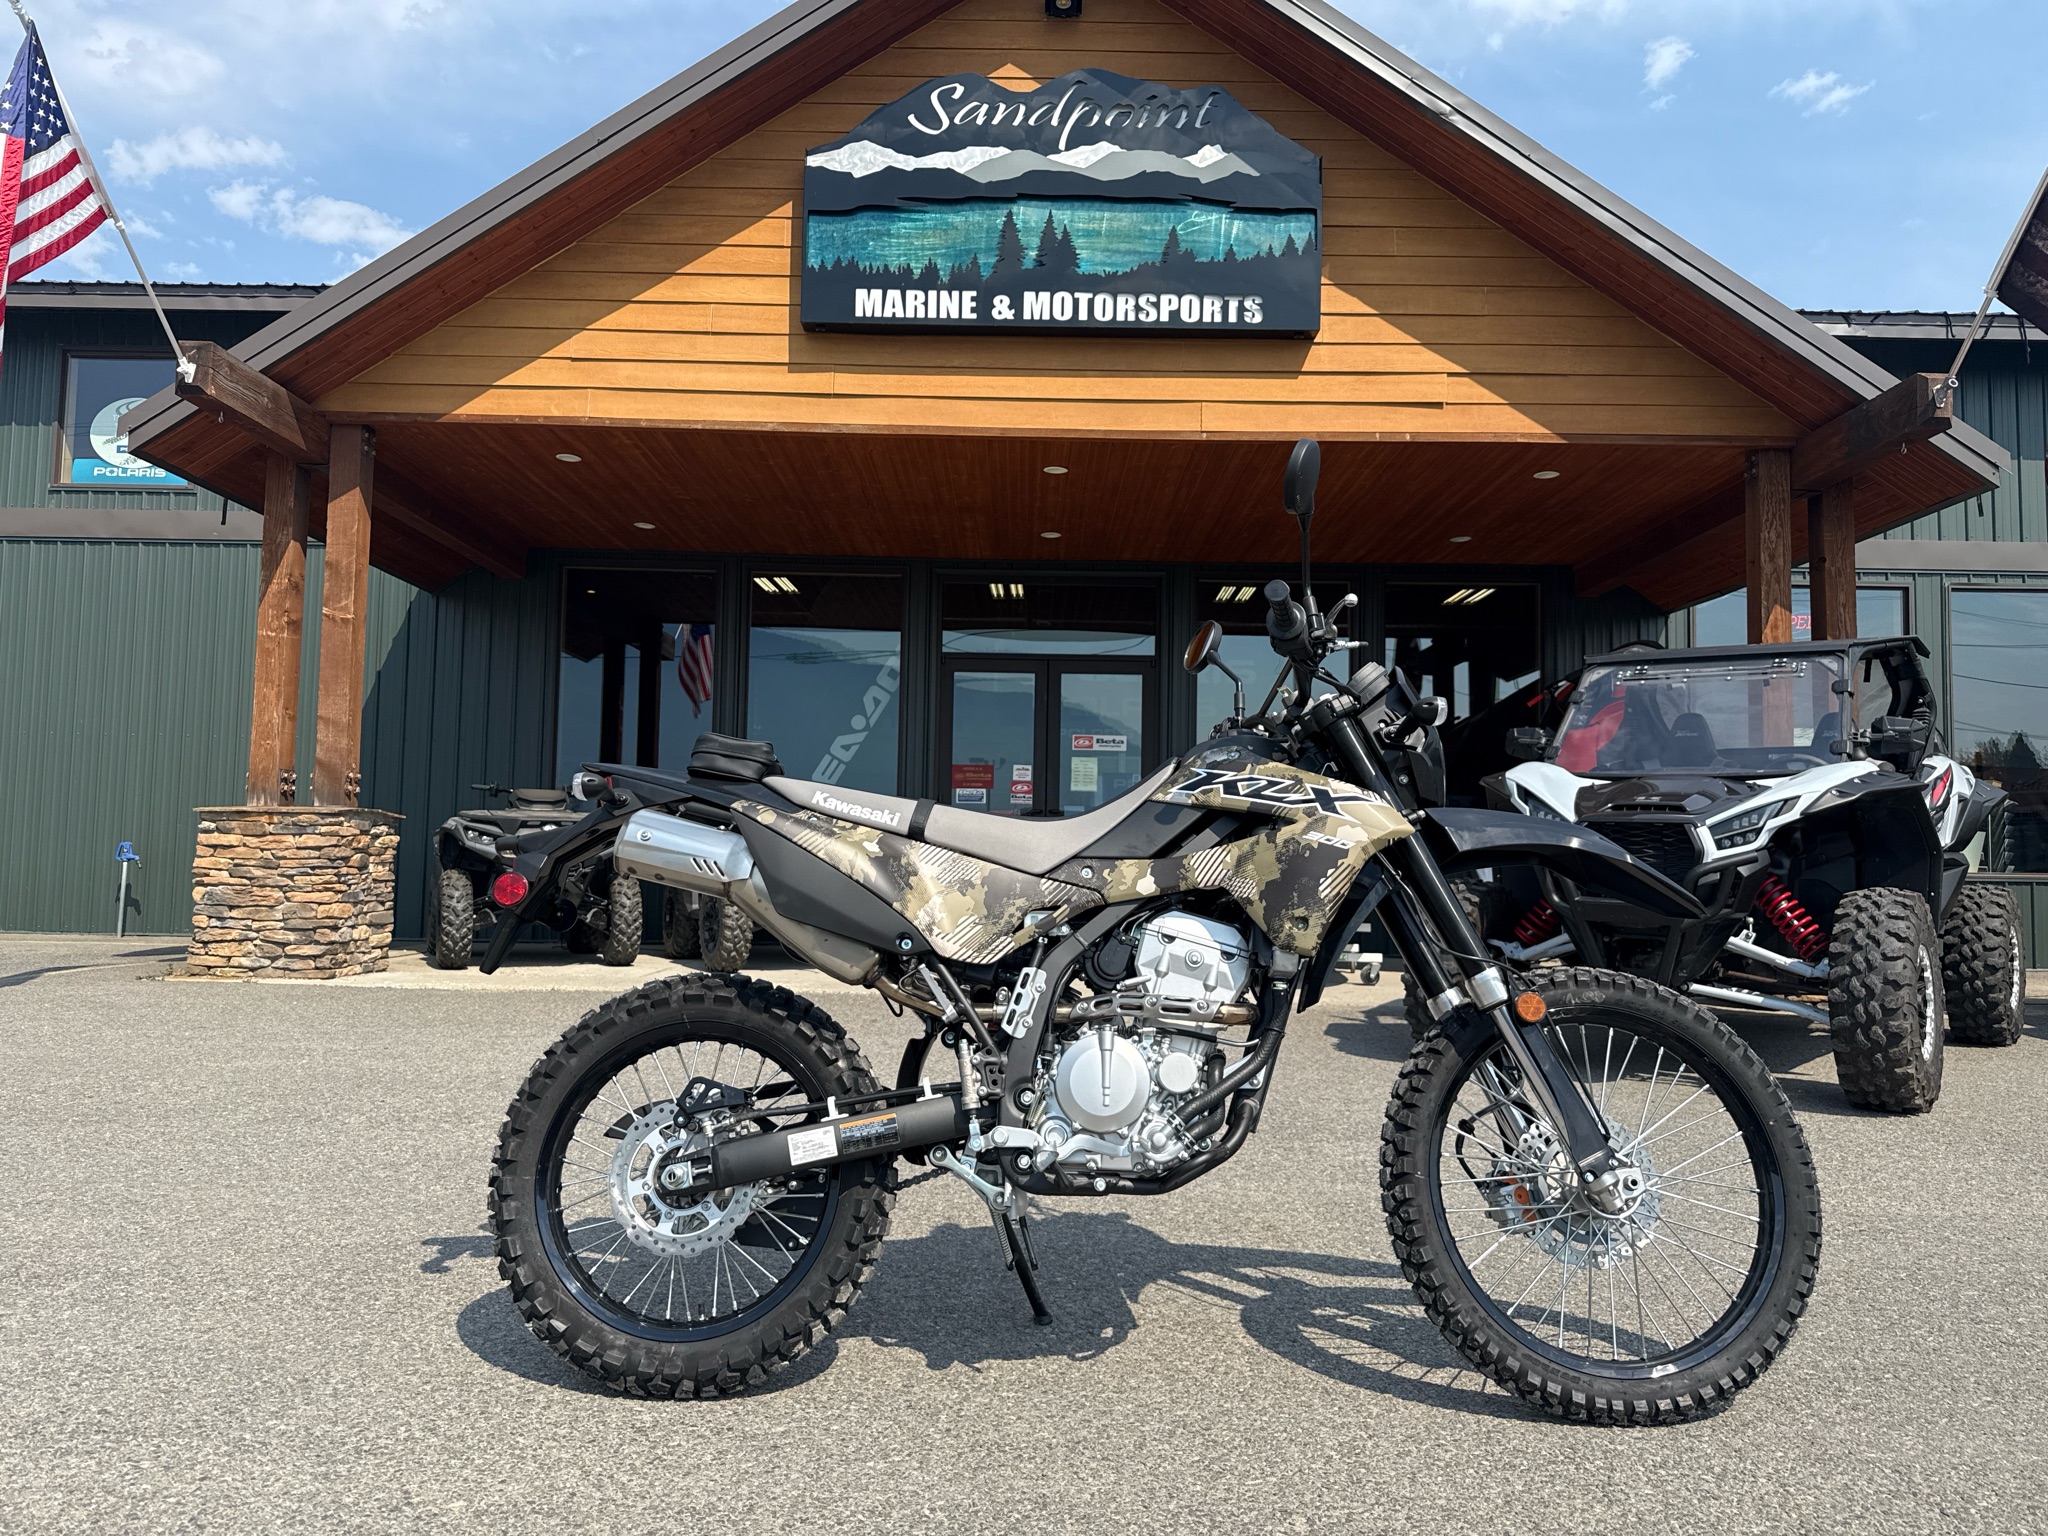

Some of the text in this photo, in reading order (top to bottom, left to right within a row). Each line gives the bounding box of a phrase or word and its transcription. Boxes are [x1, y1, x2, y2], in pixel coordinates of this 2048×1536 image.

[907, 79, 1221, 151] Sandpoint
[854, 288, 1264, 325] MARINE & MOTORSPORTS
[93, 466, 167, 478] POLARIS
[1095, 737, 1125, 745] Beta
[811, 790, 900, 827] Kawasaki
[1168, 767, 1390, 824] KLX
[1302, 831, 1357, 850] 300
